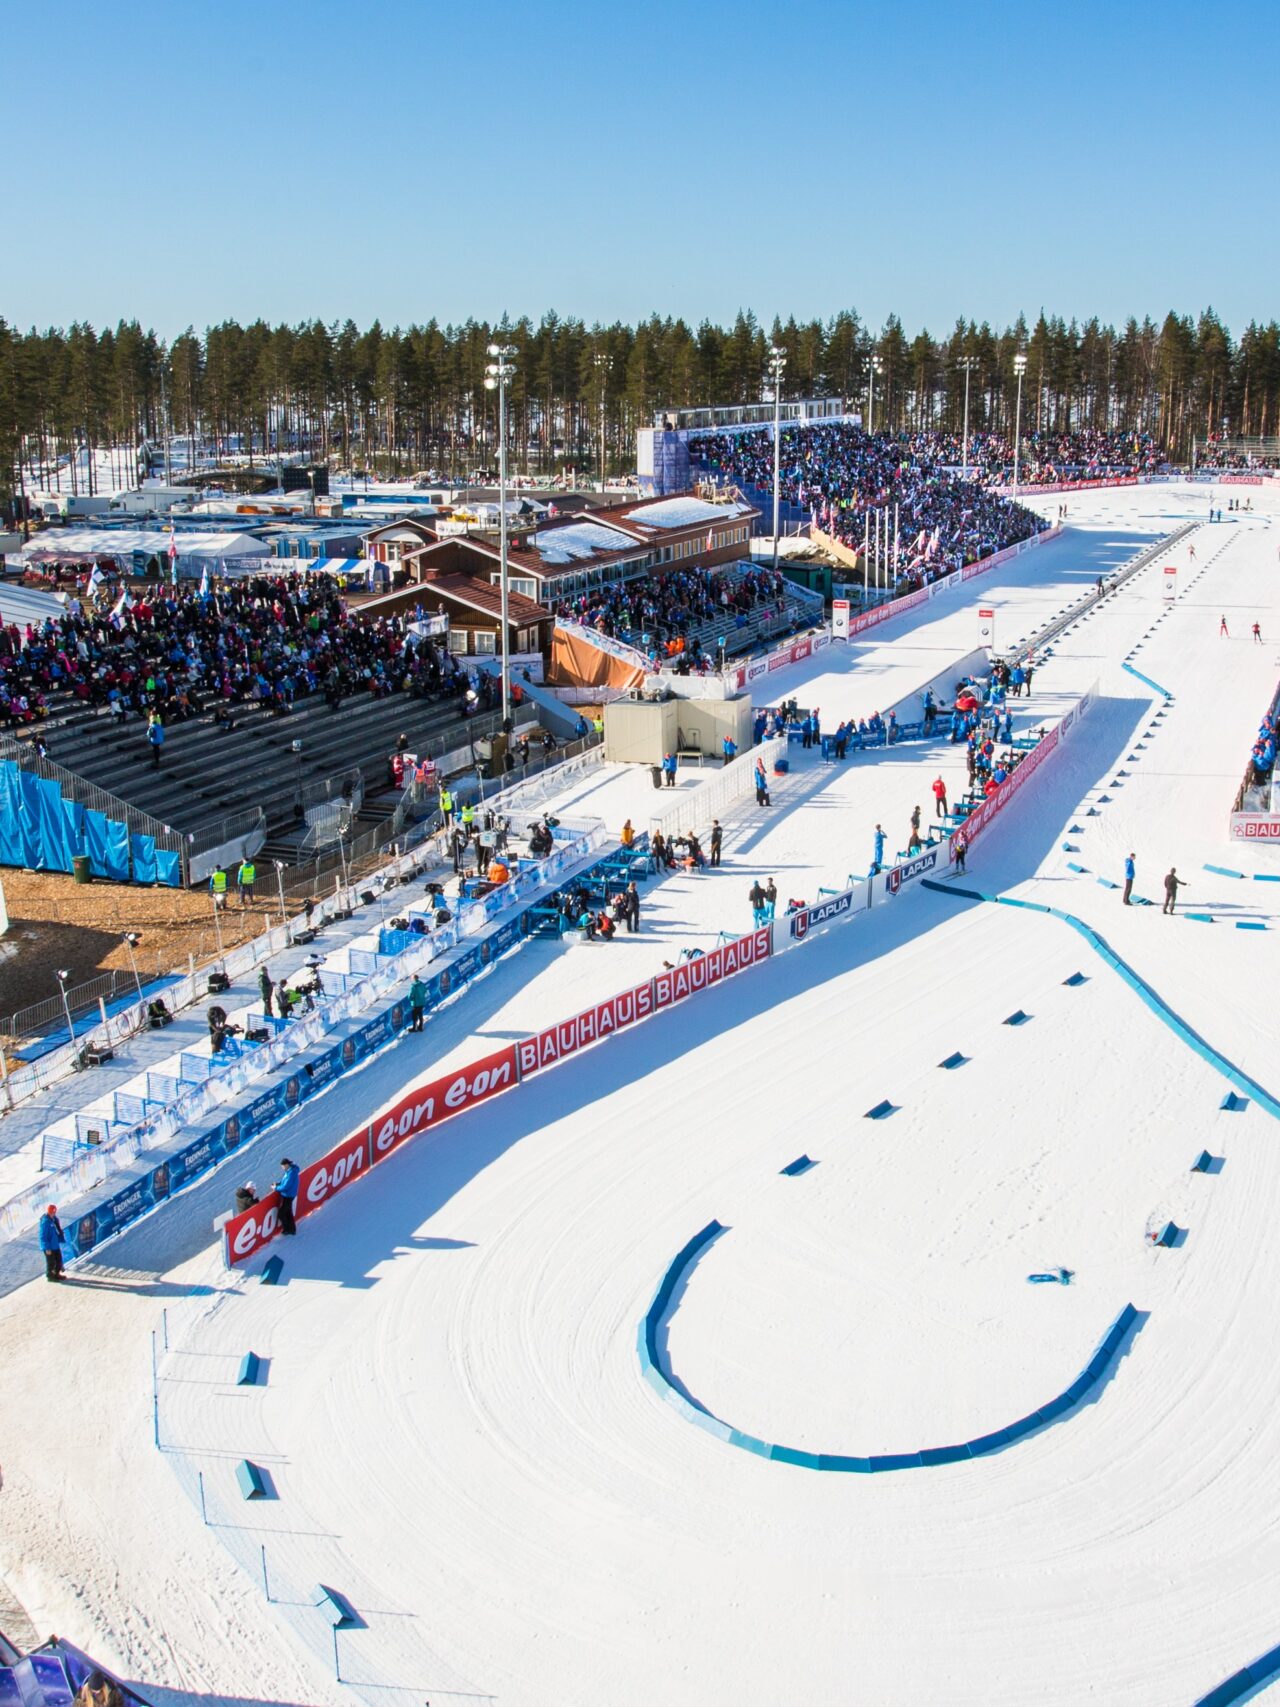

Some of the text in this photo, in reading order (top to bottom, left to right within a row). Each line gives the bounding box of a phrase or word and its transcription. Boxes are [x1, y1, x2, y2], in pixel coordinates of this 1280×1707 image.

[902, 856, 934, 879] LAPUA
[810, 898, 850, 924] LAPUA
[521, 990, 651, 1071] BAUHAUS
[656, 931, 768, 1001] BAUHAUS
